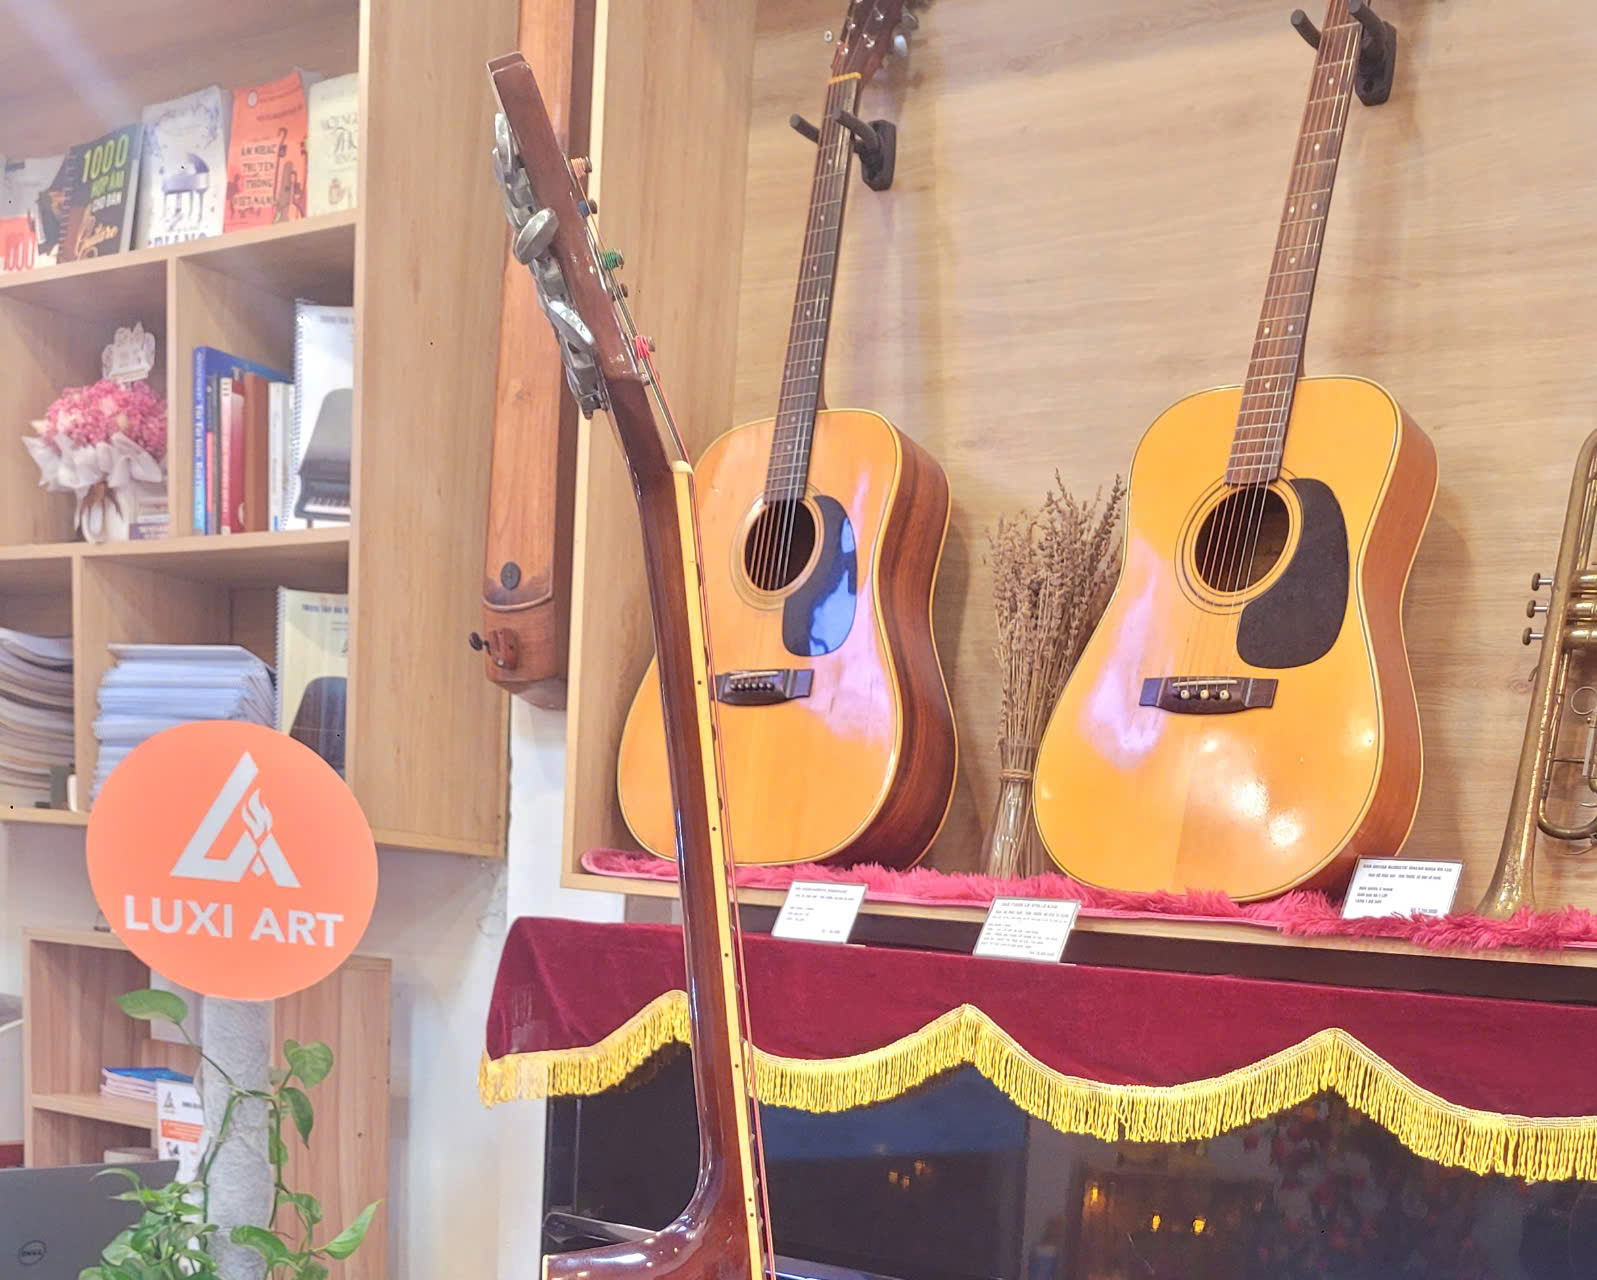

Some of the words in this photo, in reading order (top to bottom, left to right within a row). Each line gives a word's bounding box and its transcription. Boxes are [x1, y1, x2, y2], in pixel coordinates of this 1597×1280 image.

[82, 134, 130, 184] 1000
[124, 895, 233, 939] LUXI
[249, 907, 345, 948] ART
